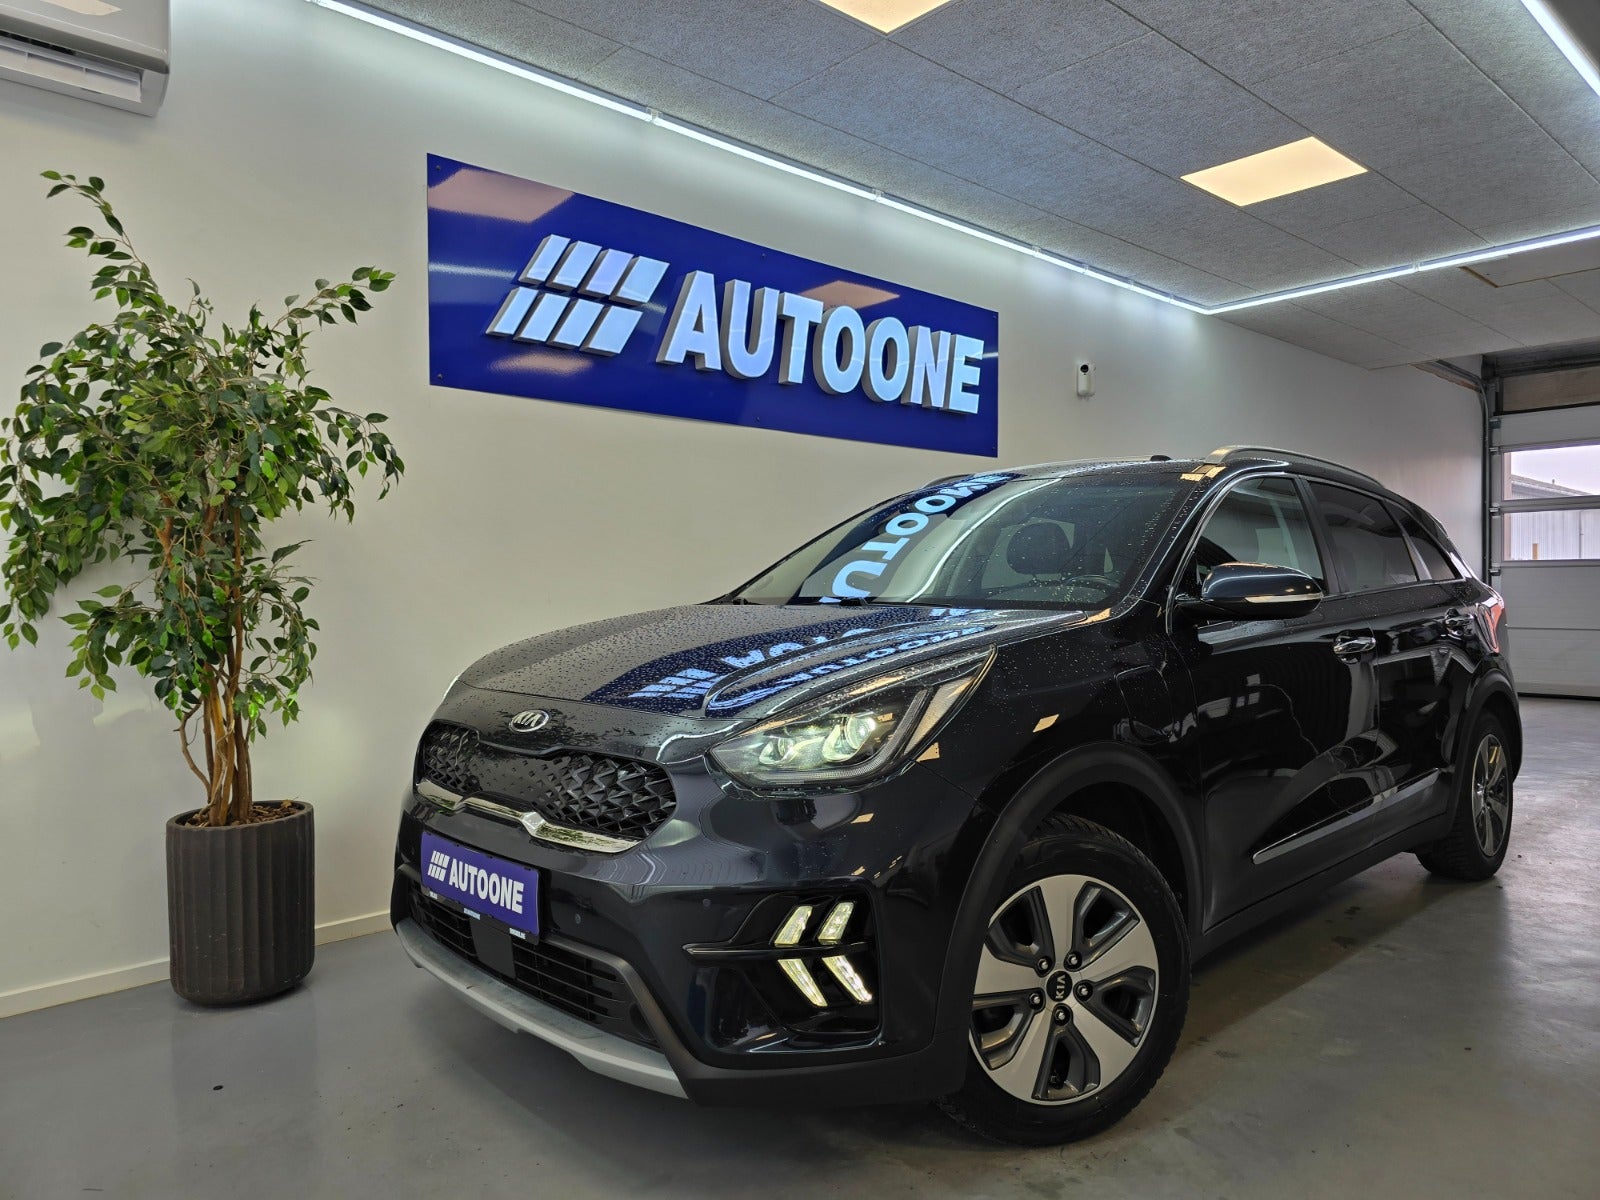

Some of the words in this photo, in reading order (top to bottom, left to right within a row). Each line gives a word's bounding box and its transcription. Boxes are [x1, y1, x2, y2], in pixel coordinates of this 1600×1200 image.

[656, 270, 984, 414] AUTOONE
[512, 711, 542, 727] KIA
[449, 858, 524, 914] AUTOONE
[1055, 974, 1066, 998] KIA
